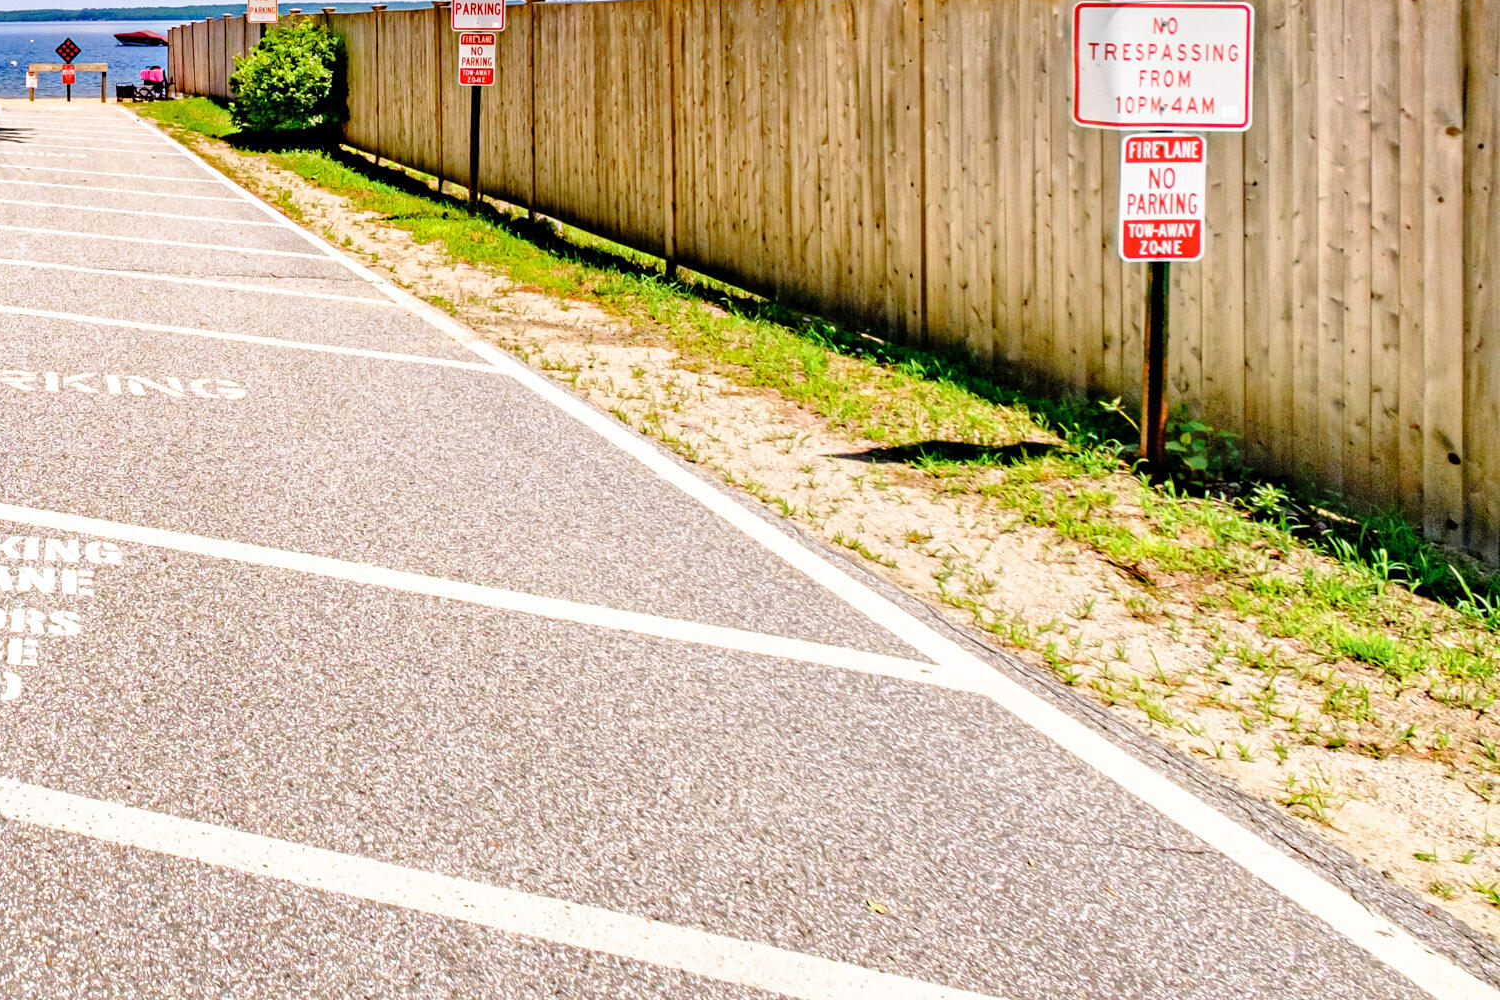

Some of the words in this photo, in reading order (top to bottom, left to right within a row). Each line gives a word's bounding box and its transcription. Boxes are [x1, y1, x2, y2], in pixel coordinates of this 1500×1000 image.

[249, 6, 276, 14] PARKING
[455, 2, 501, 16] PARKING
[1153, 17, 1178, 35] NO
[463, 35, 477, 44] FIRE
[478, 35, 493, 44] LANE
[470, 46, 483, 56] NO
[1088, 42, 1239, 62] TRESPASSING
[461, 57, 493, 67] PARKING
[462, 69, 491, 77] TOW-AWAY
[467, 76, 486, 84] ZONE
[1138, 70, 1191, 88] FROM
[1115, 96, 1215, 114] 10PM-4AM
[1128, 141, 1160, 159] FIRE
[1163, 141, 1200, 159] LANE
[1148, 167, 1175, 189] NO
[1127, 193, 1198, 215] PARKING
[1128, 223, 1196, 238] TOW-AWAY
[1138, 240, 1183, 255] ZONE
